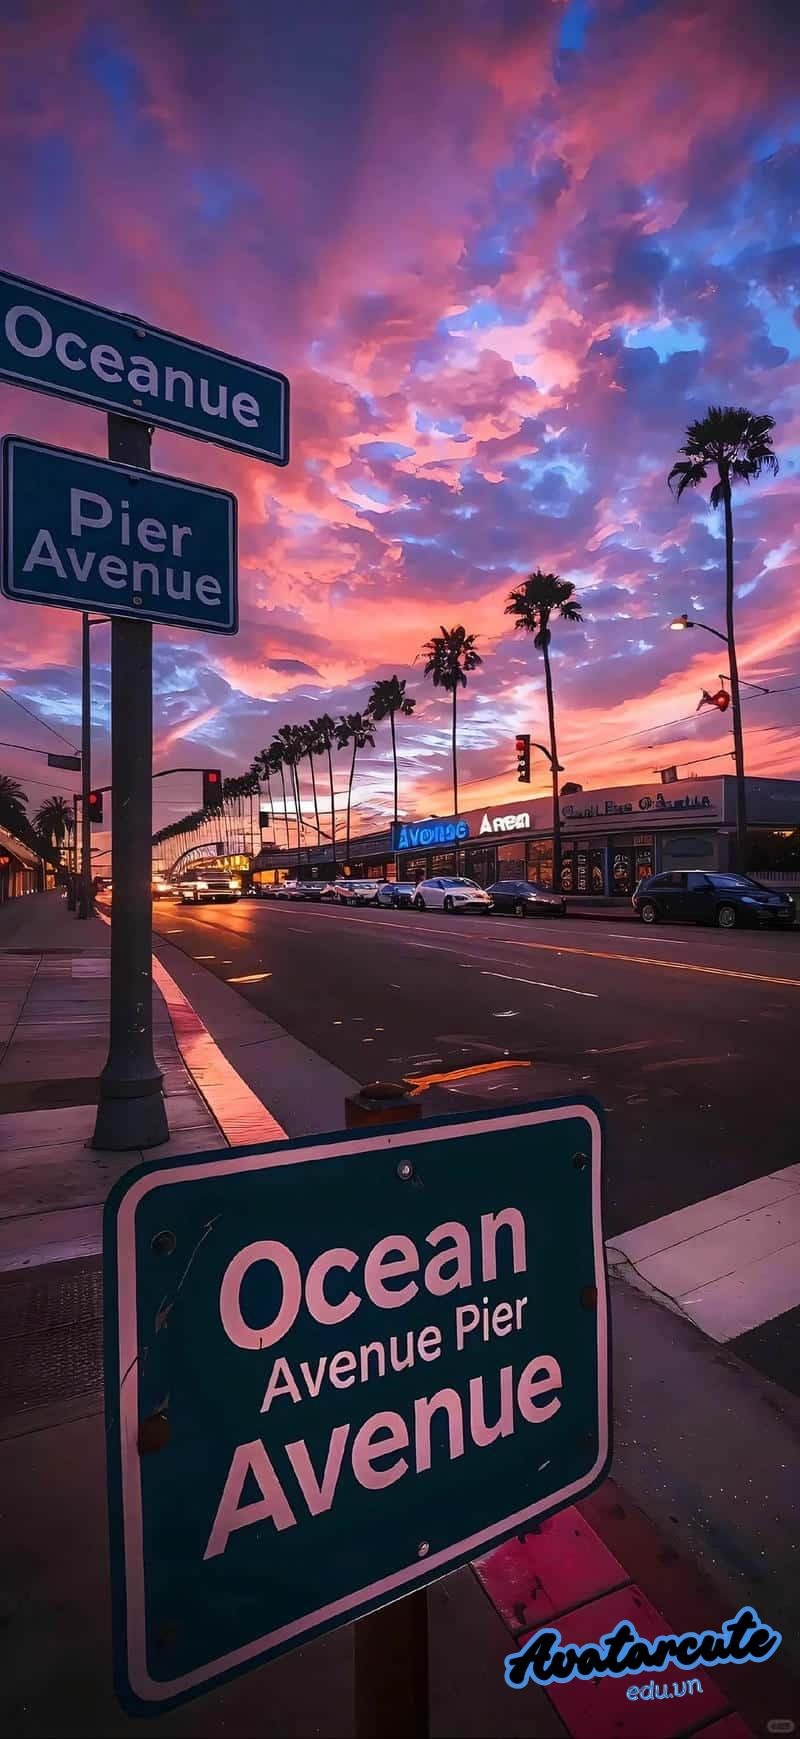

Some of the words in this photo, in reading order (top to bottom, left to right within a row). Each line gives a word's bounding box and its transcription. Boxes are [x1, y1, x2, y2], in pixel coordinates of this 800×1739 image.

[4, 305, 261, 428] Oceanue
[22, 529, 222, 606] Avenue
[70, 488, 192, 556] Pier
[219, 1207, 528, 1350] Ocean
[260, 1326, 442, 1413] Avenue
[456, 1296, 528, 1351] Pier
[203, 1355, 563, 1560] Avenue
